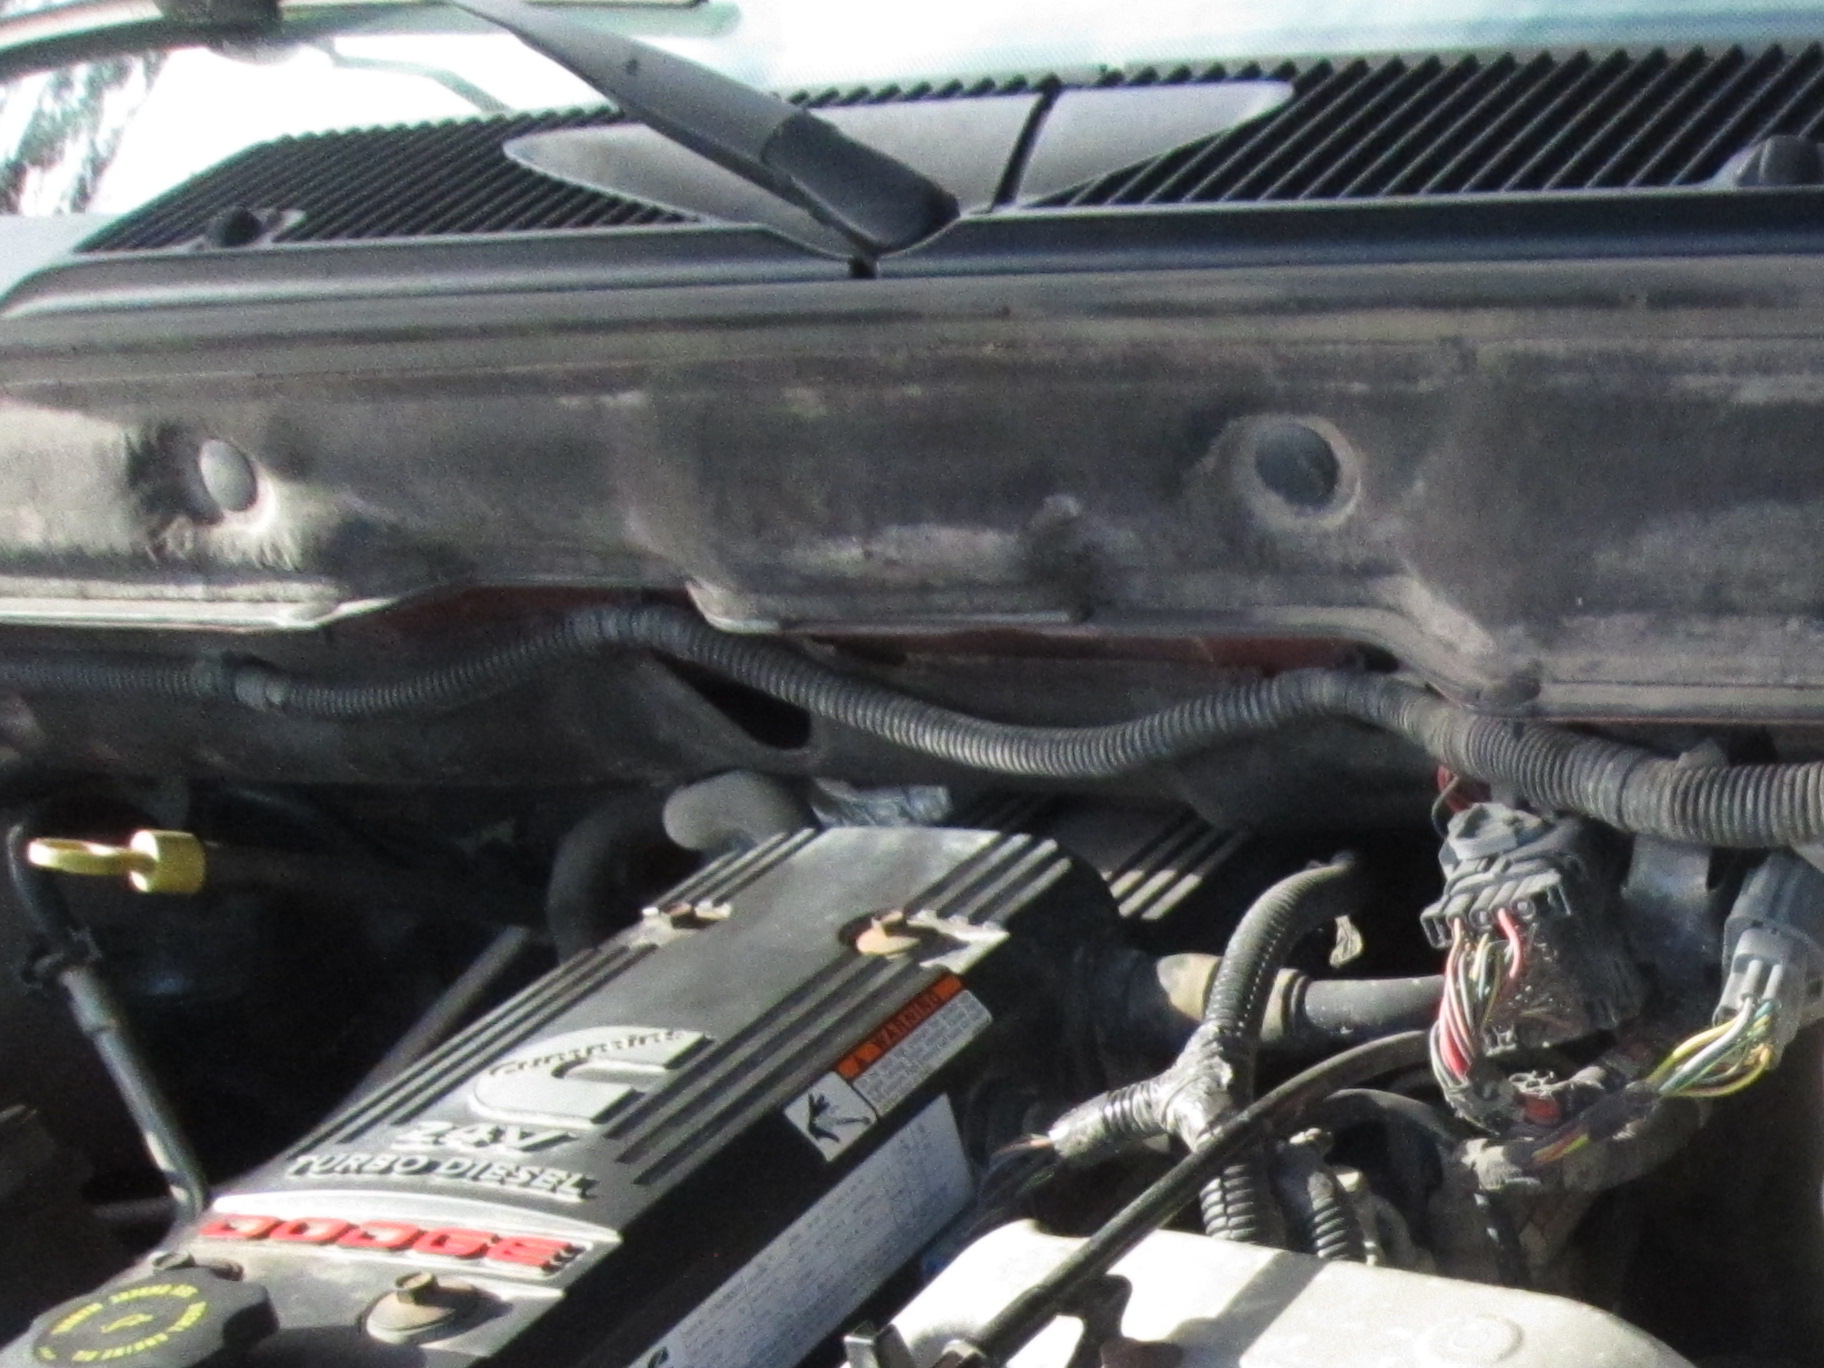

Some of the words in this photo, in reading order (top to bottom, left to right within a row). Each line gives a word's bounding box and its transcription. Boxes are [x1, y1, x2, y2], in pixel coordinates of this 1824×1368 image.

[394, 1120, 572, 1153] 24V
[288, 1152, 430, 1177] TURBO
[434, 1156, 592, 1197] DIESEL
[199, 1213, 585, 1273] DODGE
